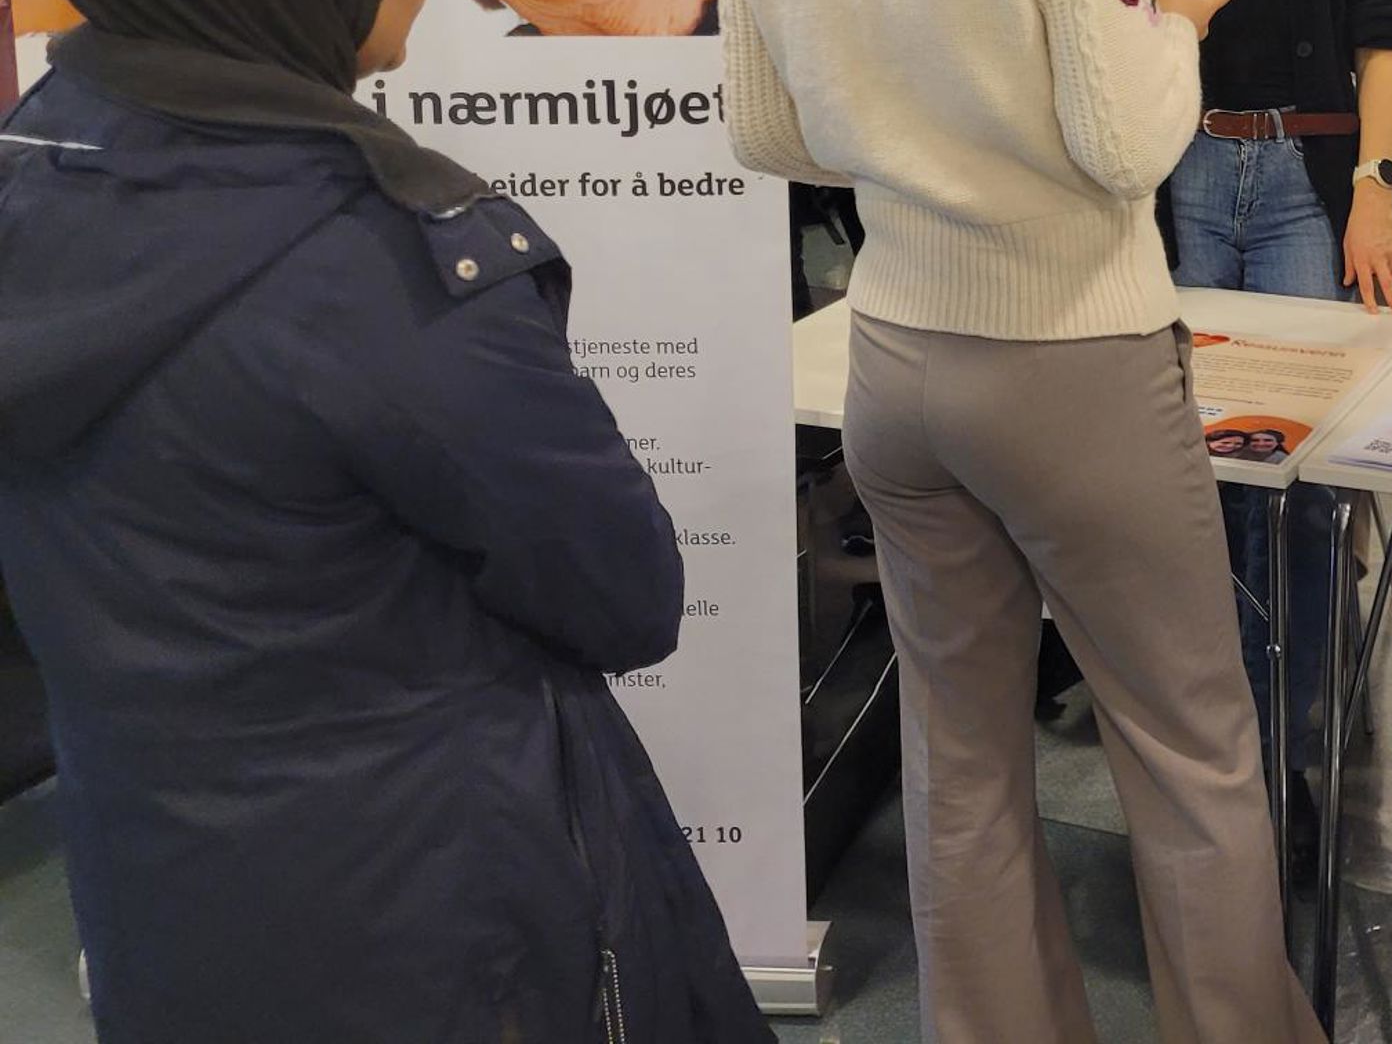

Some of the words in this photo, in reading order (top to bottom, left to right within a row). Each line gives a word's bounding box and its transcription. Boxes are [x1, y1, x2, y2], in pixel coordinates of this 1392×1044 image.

[368, 79, 388, 122] i
[408, 79, 725, 137] nærmiljøet
[490, 172, 569, 197] eider
[578, 172, 621, 197] for
[631, 171, 648, 197] å
[656, 172, 745, 197] bedre
[656, 338, 699, 354] med
[616, 367, 639, 382] og
[645, 362, 697, 378] deres
[647, 458, 712, 474] kultur-
[683, 600, 719, 616] elle
[683, 827, 706, 844] 21
[717, 826, 742, 843] 10
